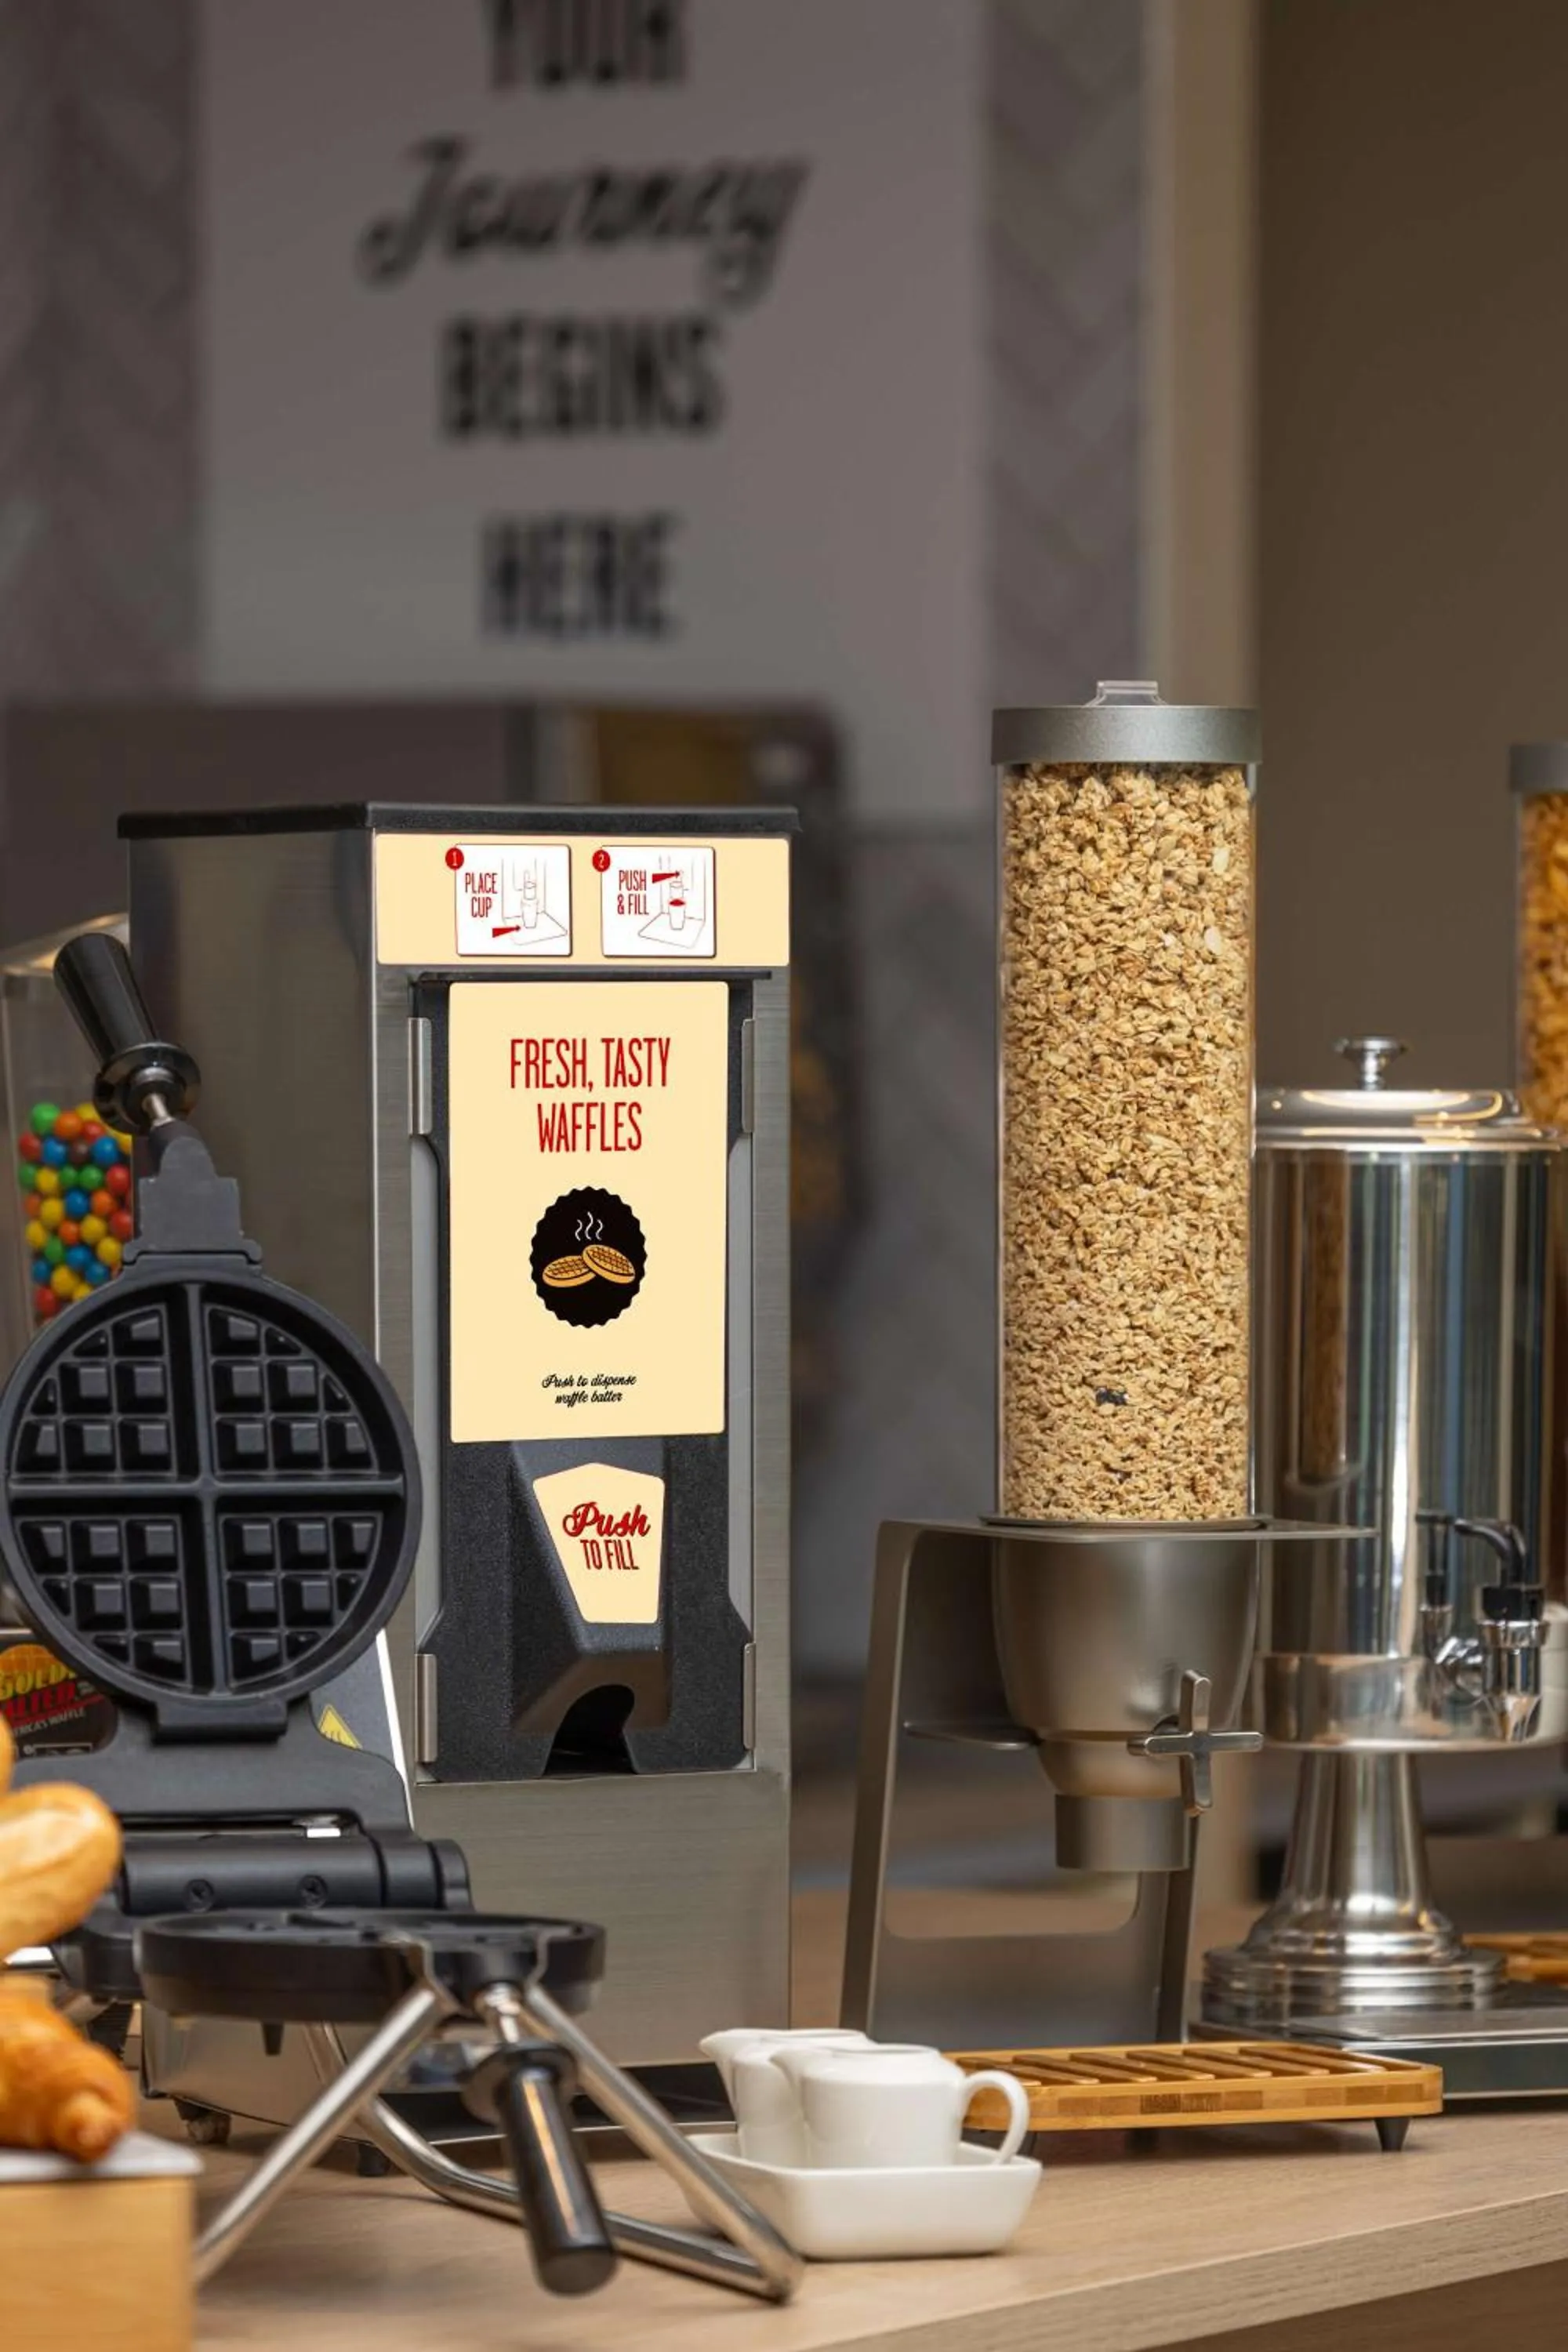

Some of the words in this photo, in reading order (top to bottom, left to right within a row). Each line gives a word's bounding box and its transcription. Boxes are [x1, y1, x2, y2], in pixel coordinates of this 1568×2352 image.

[357, 133, 811, 307] Journey
[444, 312, 726, 441] BEGINS
[484, 512, 677, 640] HERE
[464, 872, 498, 895] PLACE
[619, 869, 647, 891] PUSH
[470, 896, 493, 918] CUP
[616, 893, 625, 915] &
[627, 893, 649, 915] FILL
[510, 1037, 594, 1092] FRESH,
[601, 1036, 671, 1087] TASTY
[537, 1101, 643, 1153] WAFFLES
[541, 1373, 575, 1388] Push
[577, 1374, 589, 1387] to
[591, 1374, 637, 1389] dispense
[554, 1390, 589, 1409] waffle
[591, 1391, 623, 1403] batter
[561, 1501, 651, 1537] Push
[580, 1539, 602, 1570] TO
[604, 1539, 640, 1570] FILL
